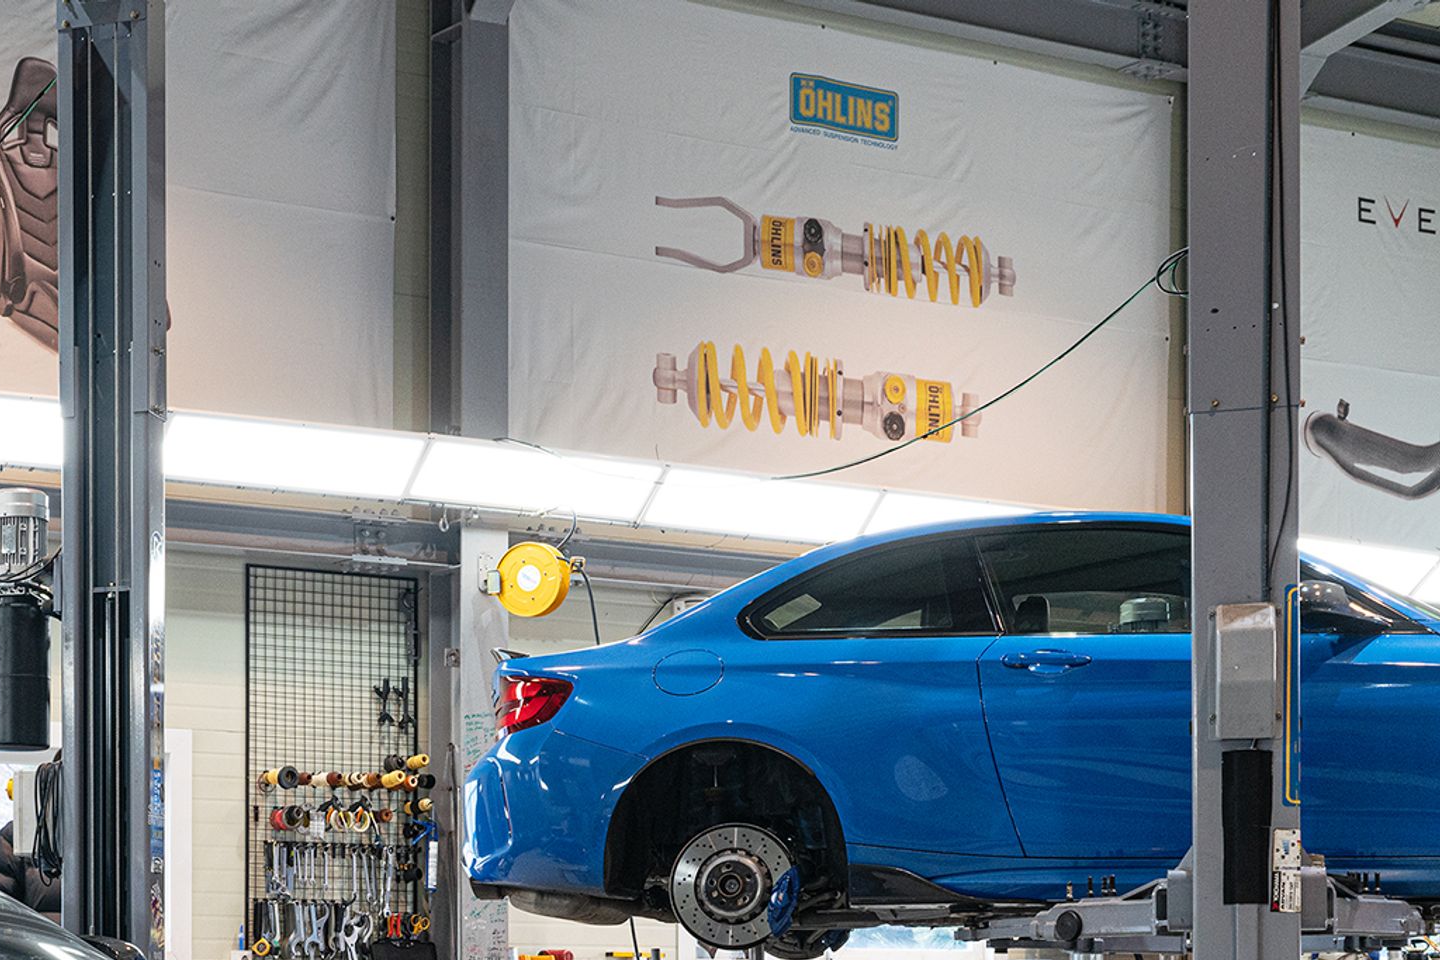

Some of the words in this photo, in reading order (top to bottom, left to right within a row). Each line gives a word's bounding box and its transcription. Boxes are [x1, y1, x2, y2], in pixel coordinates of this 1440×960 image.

[800, 80, 891, 132] ÖHLINS
[791, 126, 821, 136] ADVANCED
[823, 131, 859, 144] SUSPENSION
[861, 138, 898, 151] TECHNOLOGY
[771, 220, 785, 266] ÖHLINS
